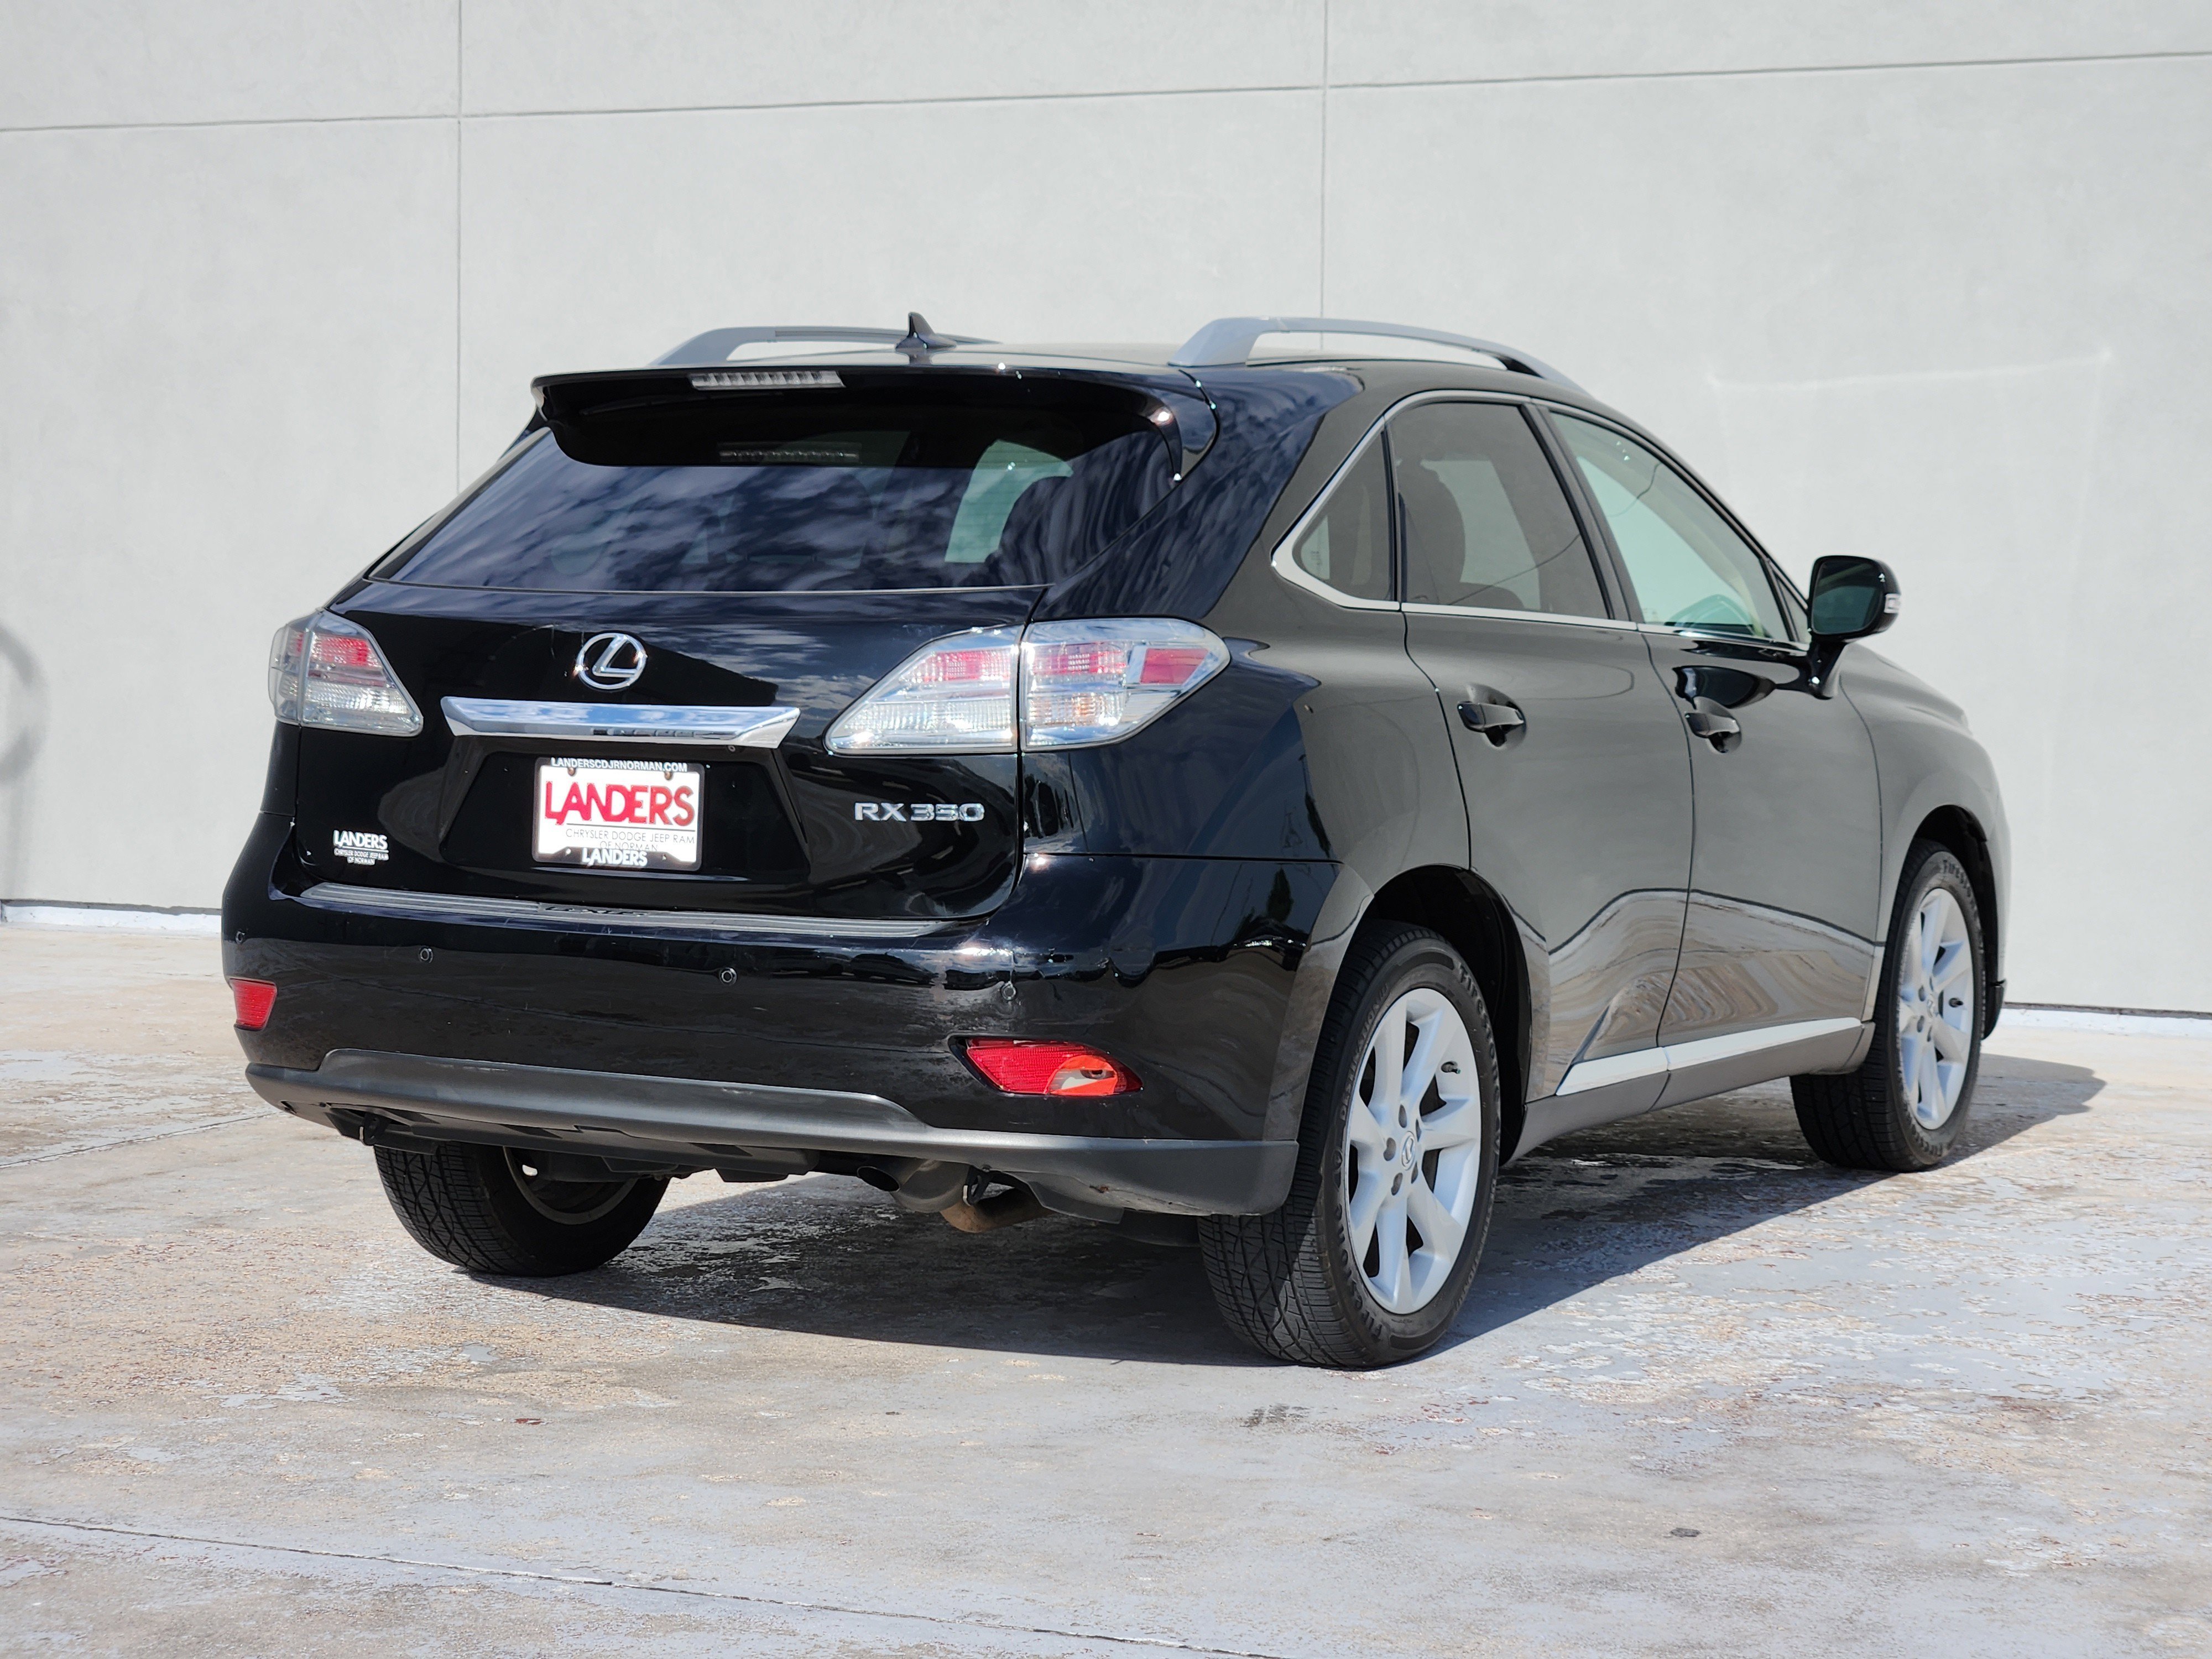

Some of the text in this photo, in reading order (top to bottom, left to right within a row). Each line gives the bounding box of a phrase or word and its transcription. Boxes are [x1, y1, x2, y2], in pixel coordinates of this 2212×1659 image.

[551, 757, 687, 772] LANDERSCDJRNORMAN.COM
[545, 780, 695, 826] LANDERS
[855, 802, 985, 822] RX 350
[333, 830, 388, 850] LANDERS
[566, 828, 695, 844] CHRYSLER DODGE JEEP RAM
[600, 841, 658, 851] OF NORMAN
[582, 847, 648, 867] LANDERS
